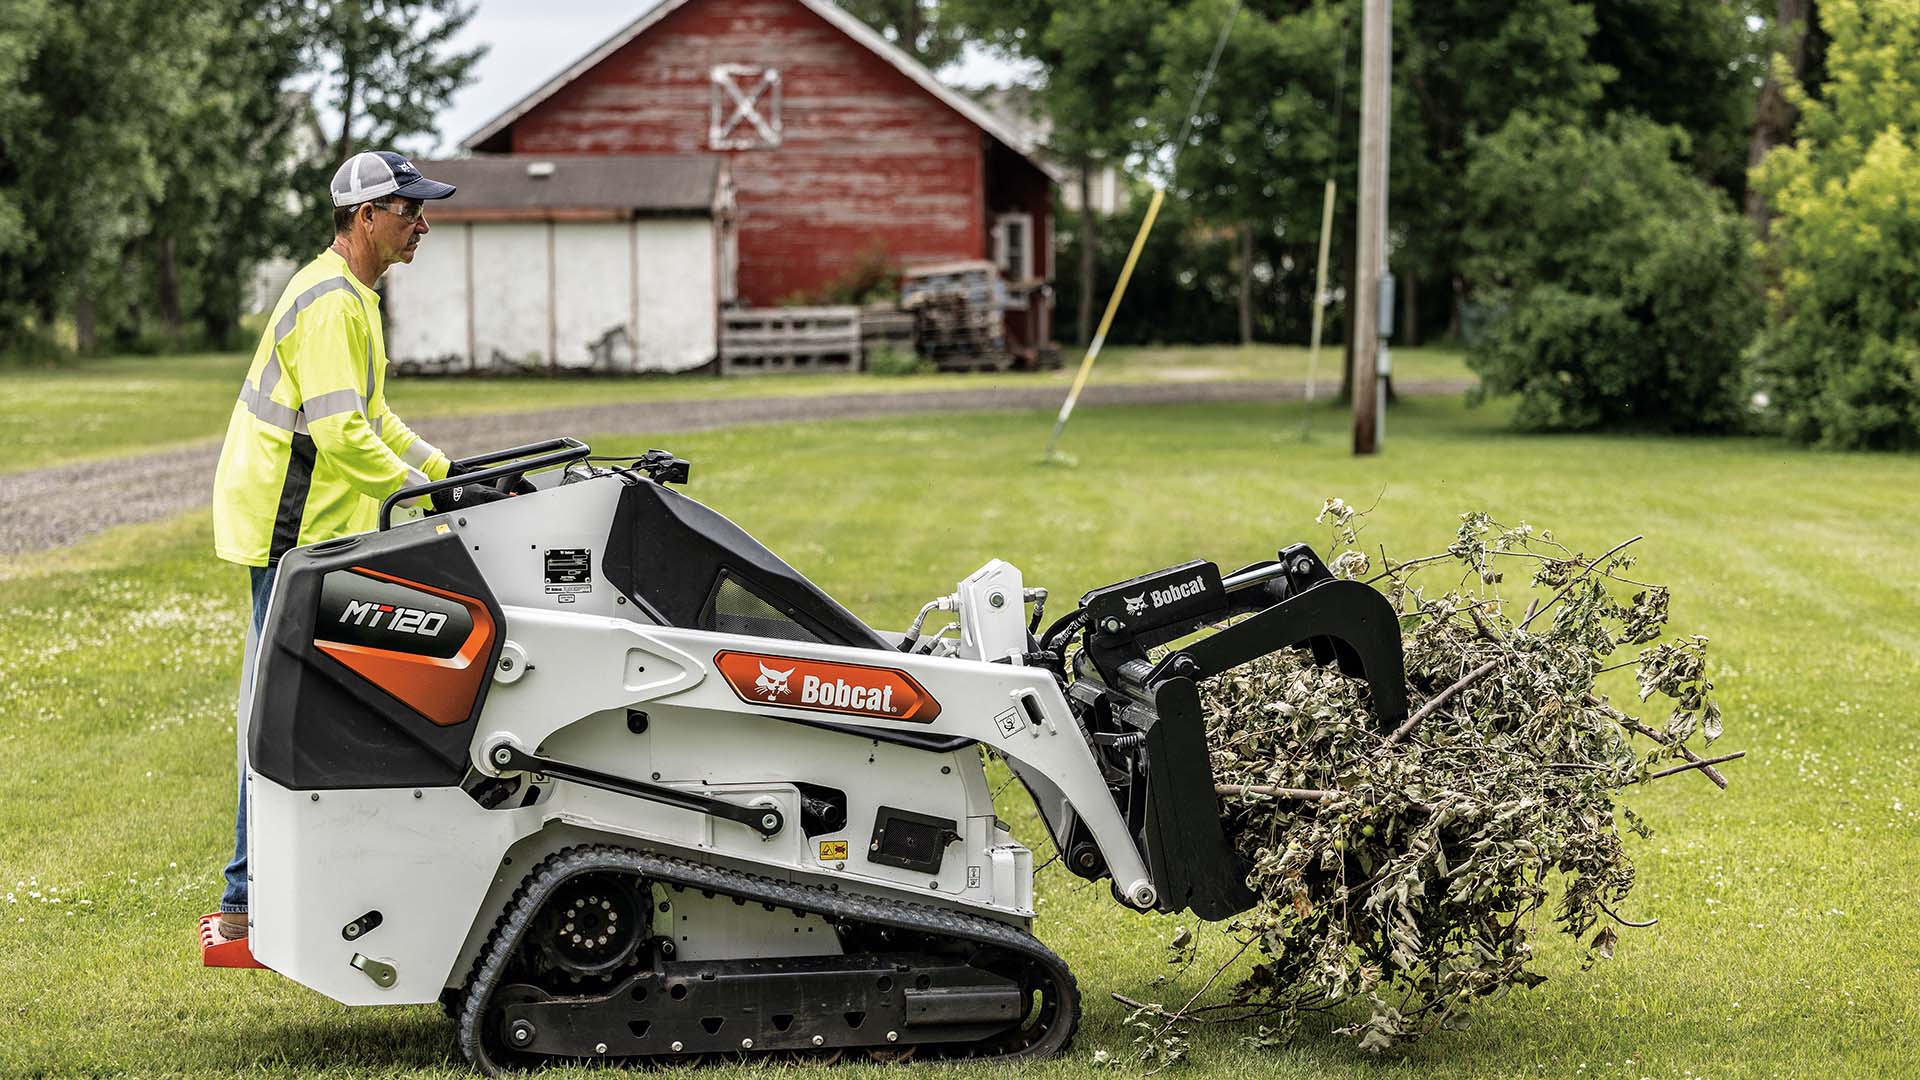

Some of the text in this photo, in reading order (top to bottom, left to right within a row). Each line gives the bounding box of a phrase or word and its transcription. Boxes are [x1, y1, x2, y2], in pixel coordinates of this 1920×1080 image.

[1150, 575, 1206, 608] Bobcat
[339, 600, 448, 637] MT120
[801, 675, 893, 712] Bobcat
